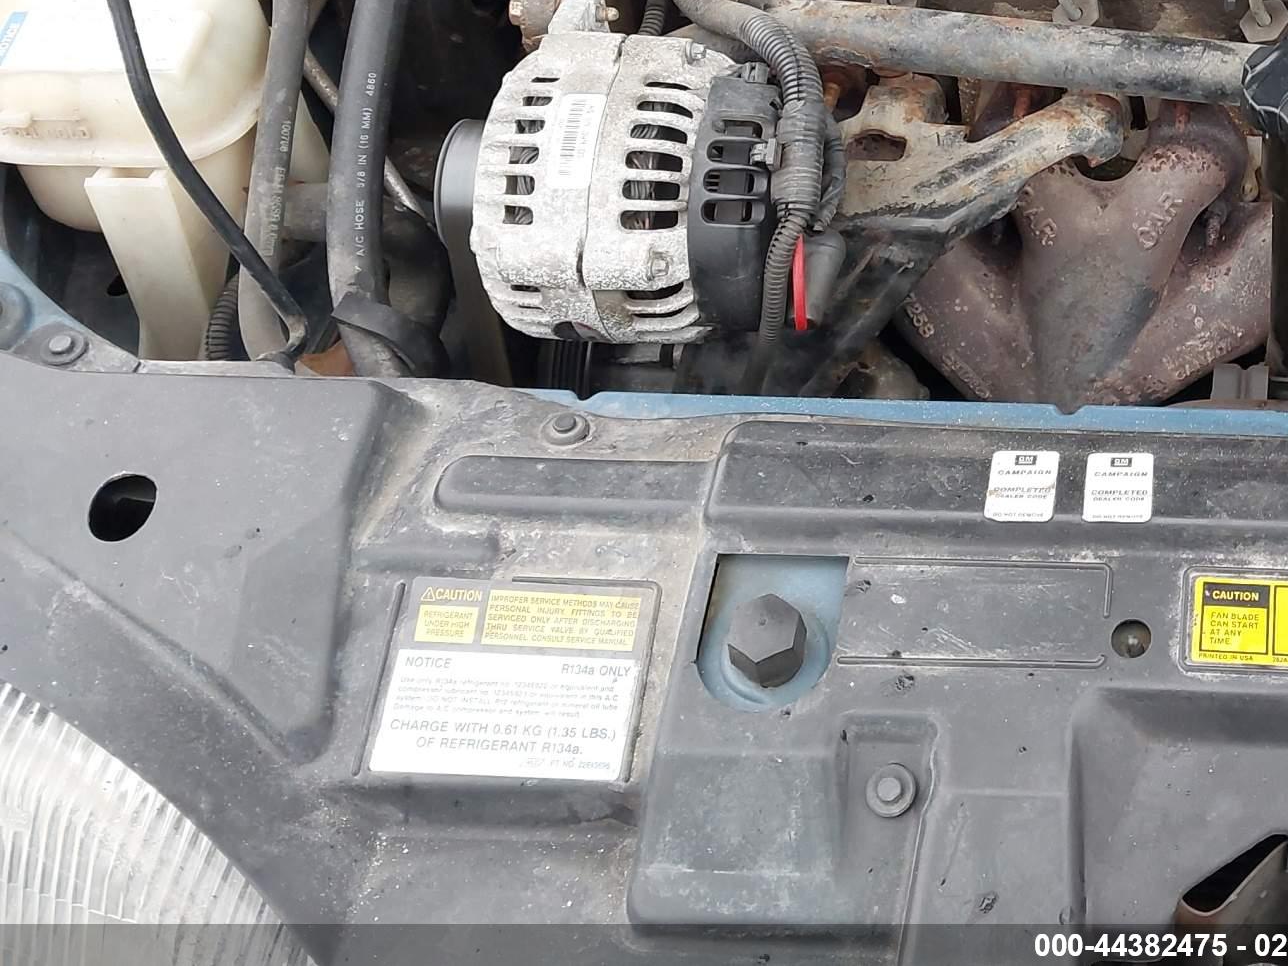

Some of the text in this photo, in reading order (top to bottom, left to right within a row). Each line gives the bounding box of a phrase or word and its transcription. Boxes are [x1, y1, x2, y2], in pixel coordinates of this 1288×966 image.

[362, 107, 374, 129] MM)
[357, 154, 368, 165] IN
[354, 200, 365, 230] HOSE
[355, 236, 365, 257] A/C
[992, 486, 1051, 494] COMPLETED
[435, 588, 483, 602] CAUTION
[1212, 590, 1260, 601] CAUTION
[491, 595, 639, 610] IMPROPER SERVICE METHODS MAY CAUSE
[423, 610, 473, 619] REFRIGERANT
[489, 604, 530, 613] PERSONAL
[571, 608, 606, 618] FITTINGS
[611, 610, 622, 618] TO
[626, 611, 637, 619] BE
[1210, 611, 1260, 622] FAN BLADE
[424, 619, 470, 628] UNDER HIGH
[487, 614, 636, 628] SERVICED ONLY AFTER DISCHARGING
[1231, 621, 1259, 630] START
[425, 628, 465, 638] PRESSURE
[486, 622, 508, 631] THRU
[512, 624, 545, 633] SERVICE
[550, 626, 576, 634] VALVE
[594, 628, 634, 637] QUALIFIED
[1209, 628, 1242, 637] AT ANY
[531, 634, 565, 643] CONSULT
[566, 635, 596, 645] SERVICE
[404, 656, 452, 669] NOTICE
[1198, 652, 1228, 660] PRINTED
[561, 663, 633, 677] R134a ONLY
[390, 718, 617, 742] CHARGE WITH 0.61 KG (1.35 LBS.)
[416, 736, 584, 755] OF REFRIGERANT R134a.
